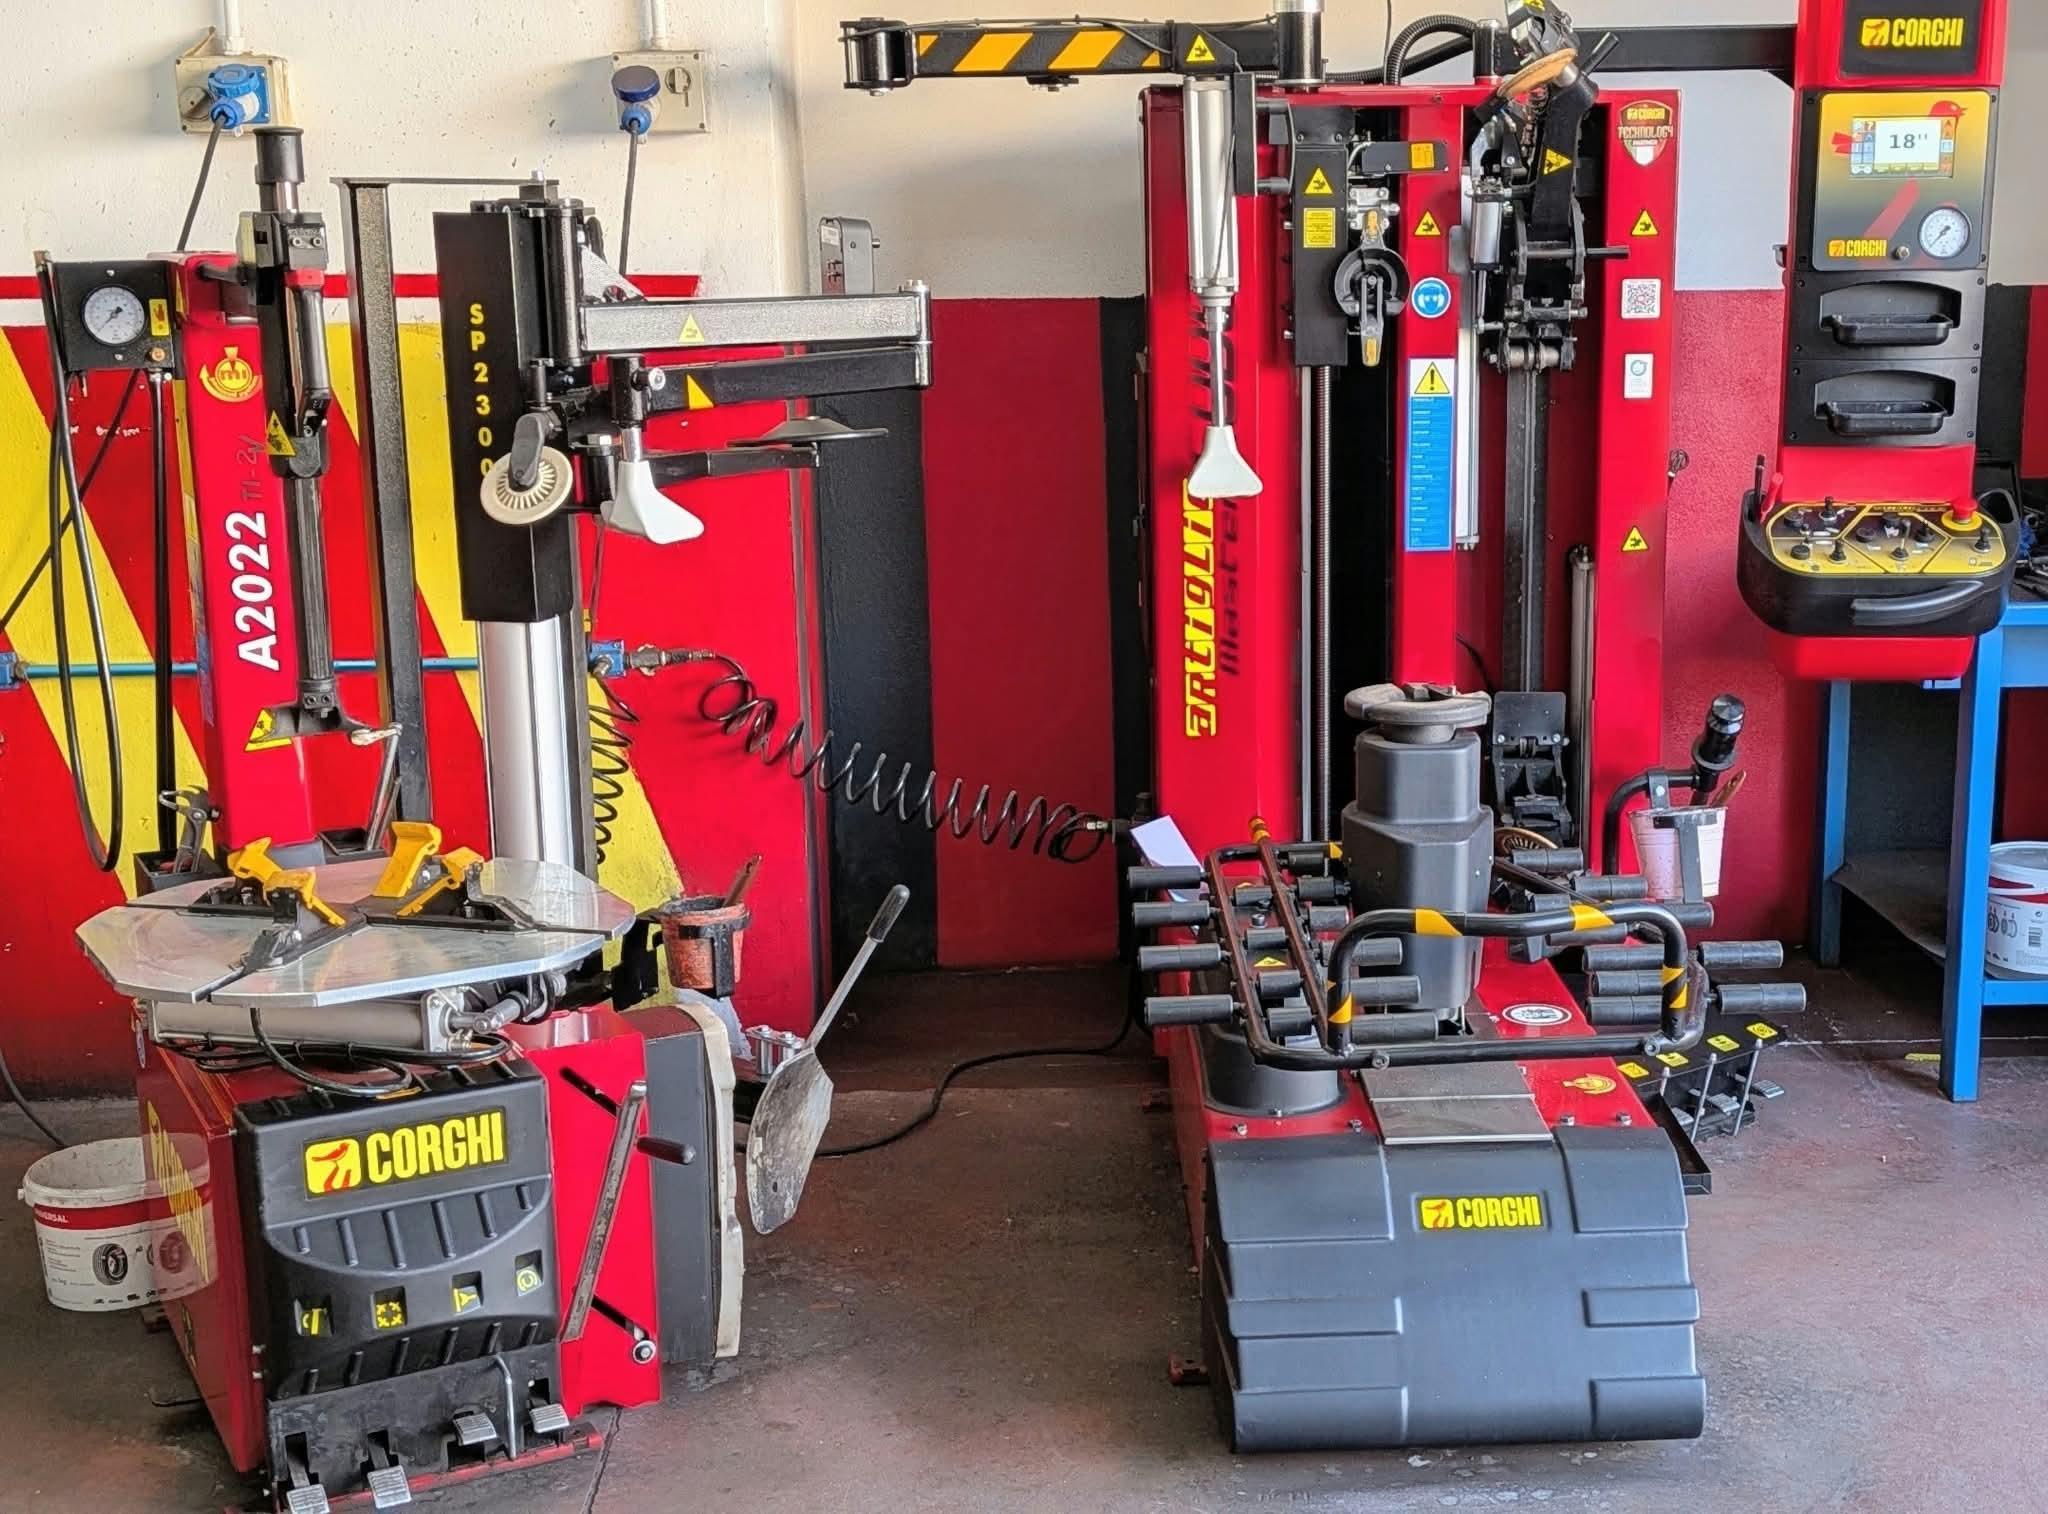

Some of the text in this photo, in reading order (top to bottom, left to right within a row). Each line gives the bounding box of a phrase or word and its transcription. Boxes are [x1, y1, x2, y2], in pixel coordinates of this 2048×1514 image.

[1892, 17, 1964, 47] CORGHI
[1846, 239, 1887, 257] CORGHI
[224, 511, 281, 672] A2022
[366, 1112, 504, 1184] CORGHI
[1456, 1196, 1541, 1228] CORGHI
